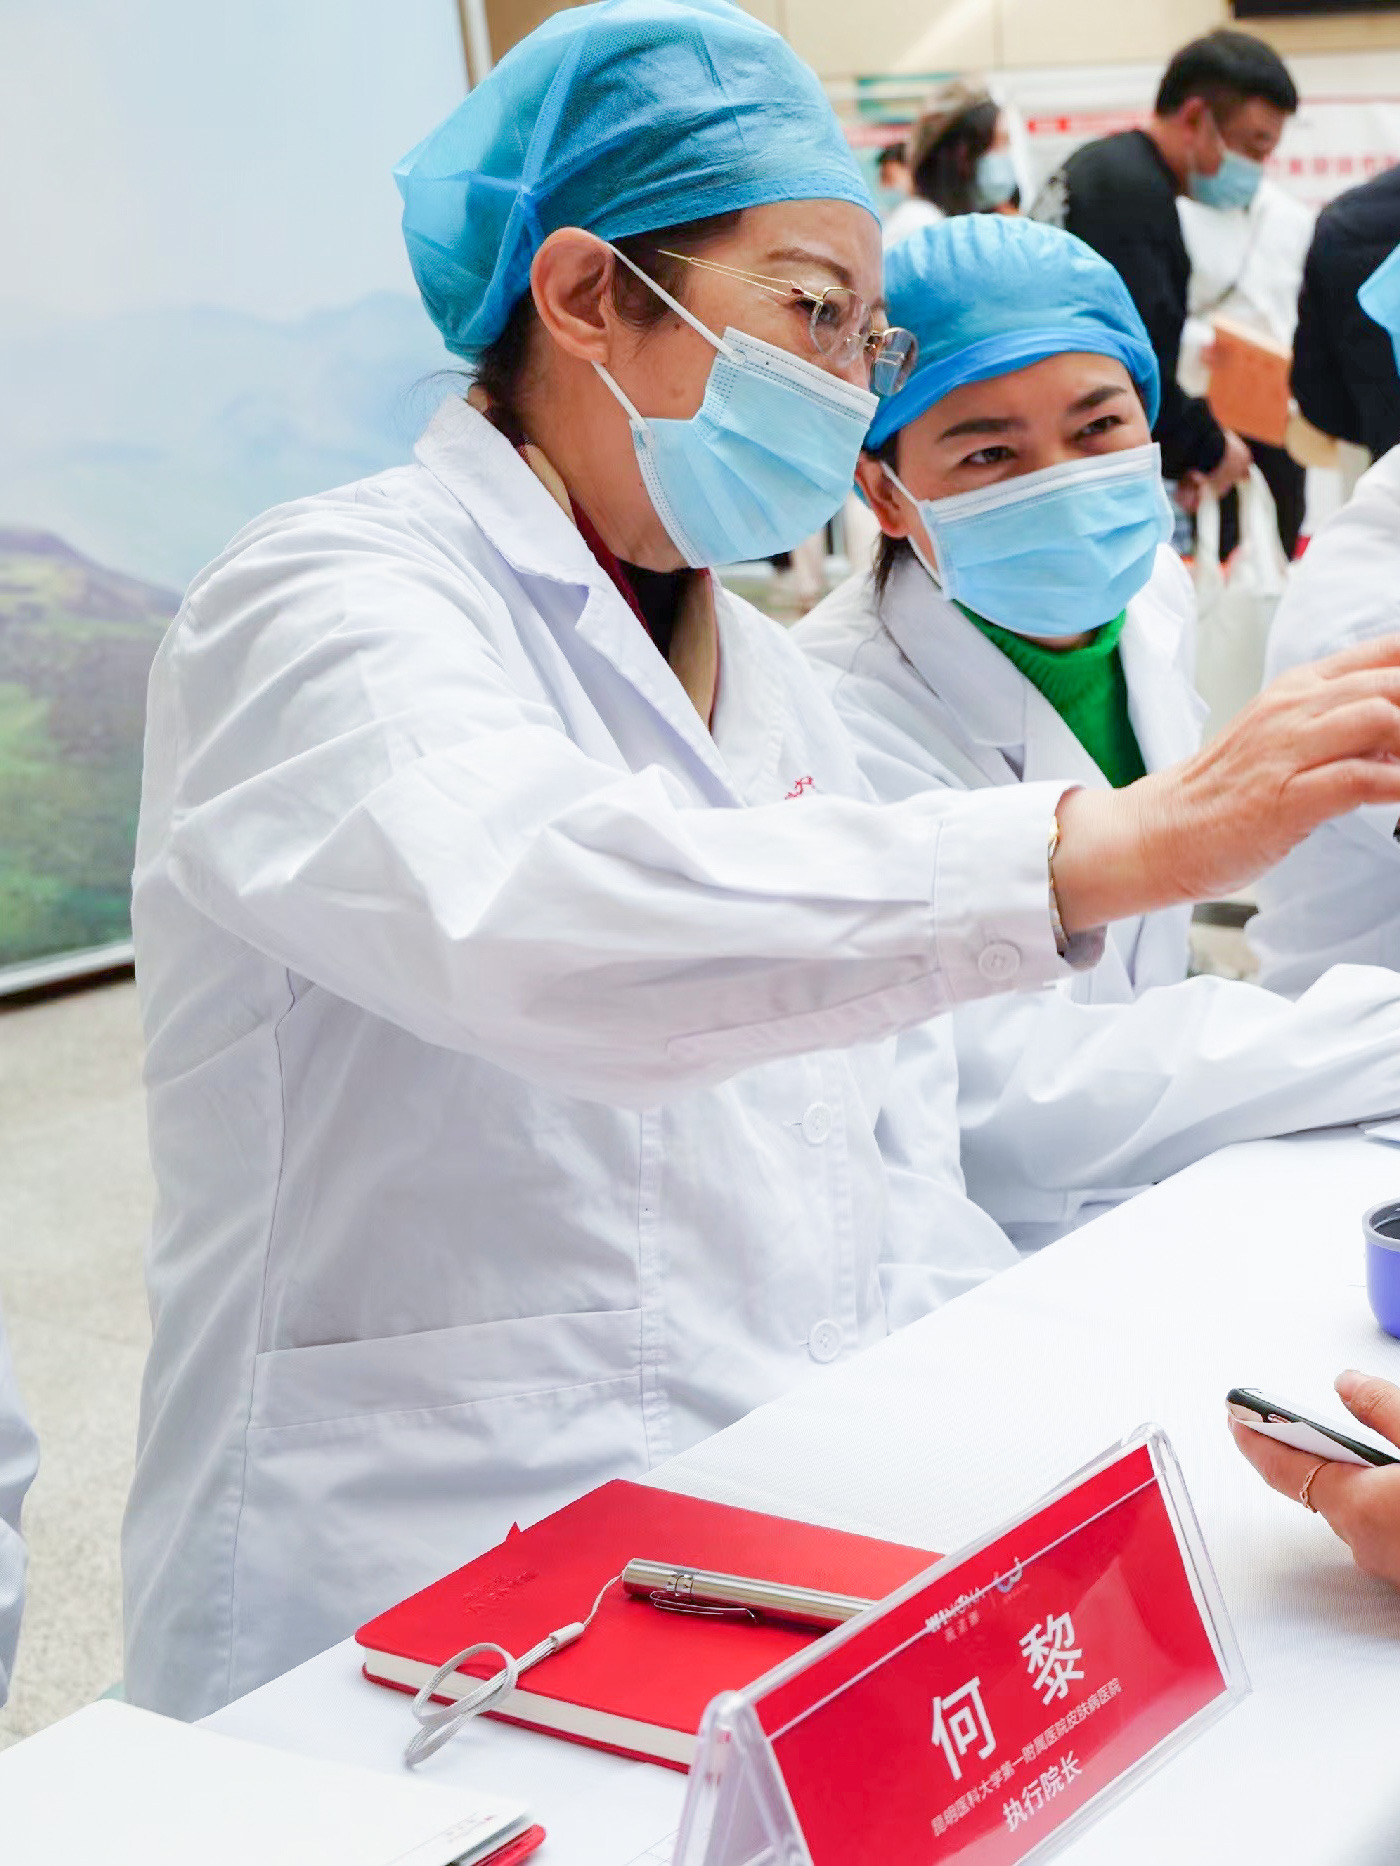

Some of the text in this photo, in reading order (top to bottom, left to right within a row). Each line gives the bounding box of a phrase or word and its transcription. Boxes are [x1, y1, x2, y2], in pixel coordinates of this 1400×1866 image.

[931, 1612, 1085, 1781] 何黎
[1003, 1750, 1083, 1833] 执行院长
